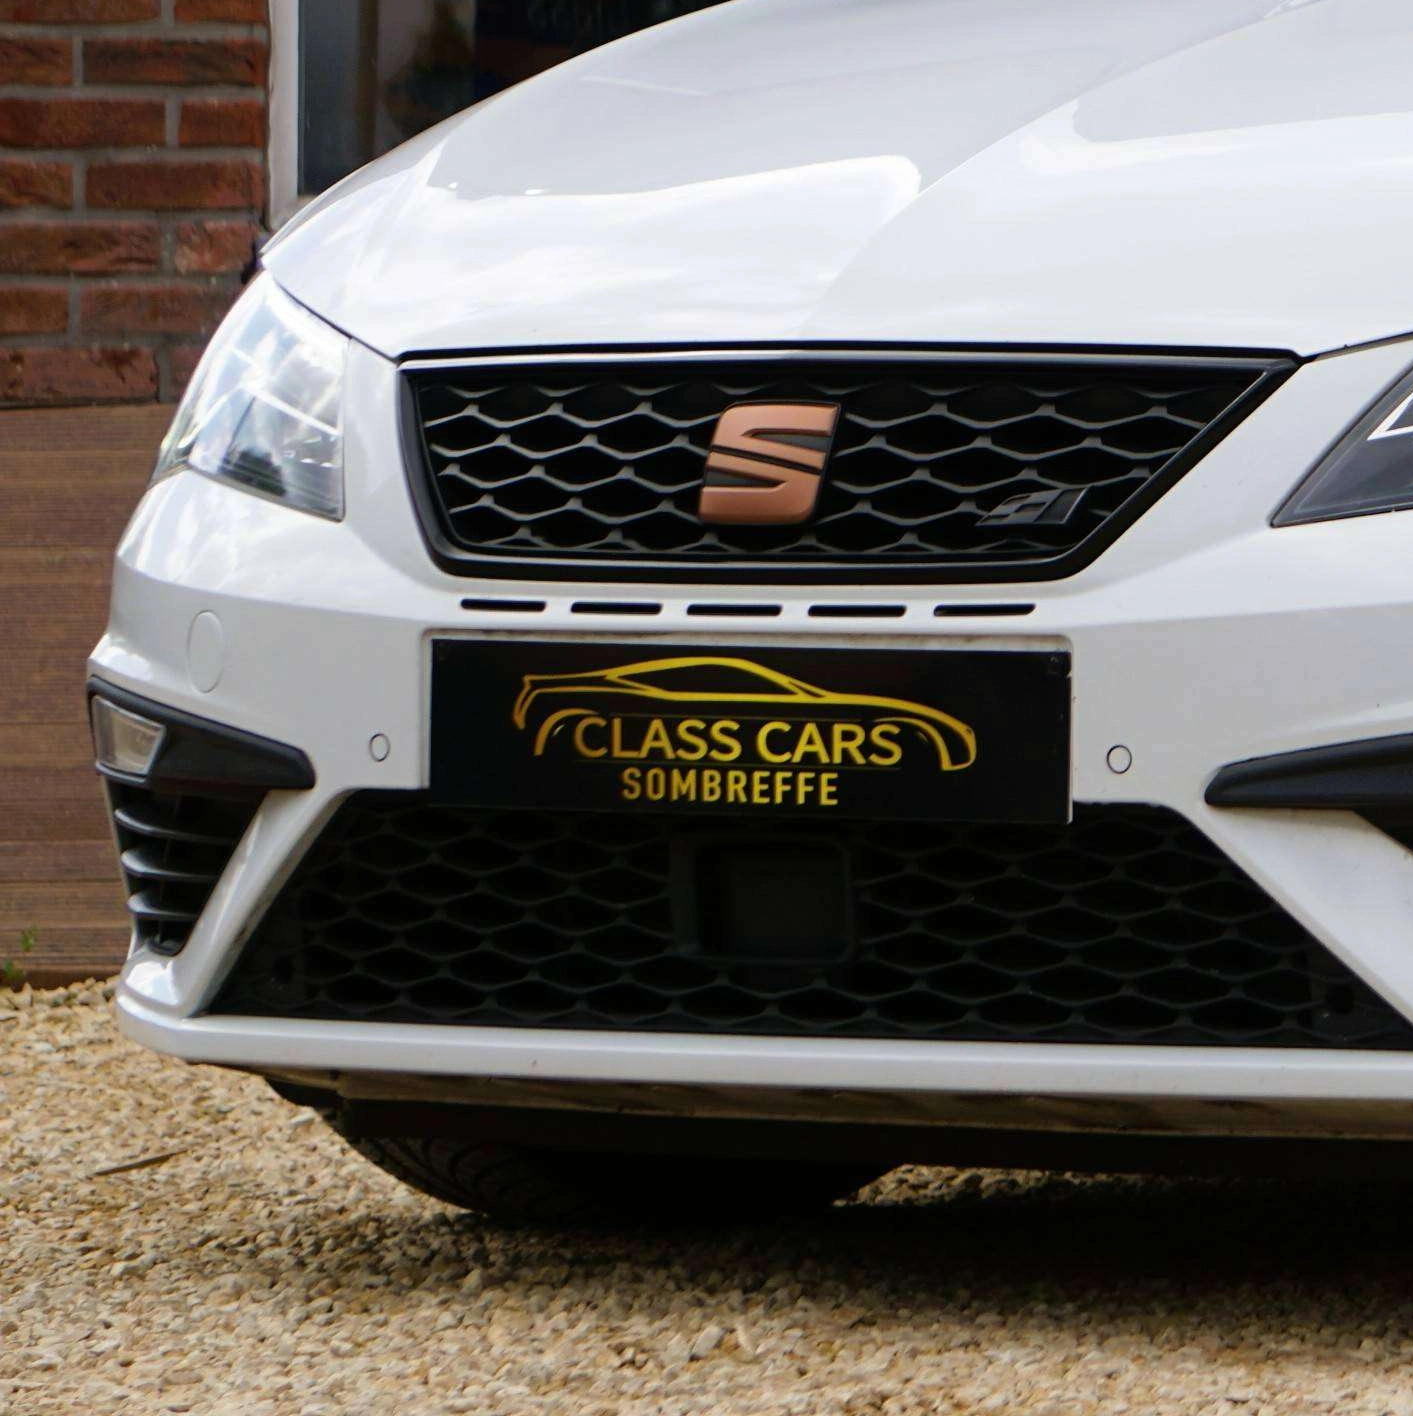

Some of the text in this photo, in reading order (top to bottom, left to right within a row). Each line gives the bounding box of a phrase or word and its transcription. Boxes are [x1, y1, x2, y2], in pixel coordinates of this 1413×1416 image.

[572, 716, 904, 766] CLASS CARS
[621, 766, 839, 806] SOMBREFFE
